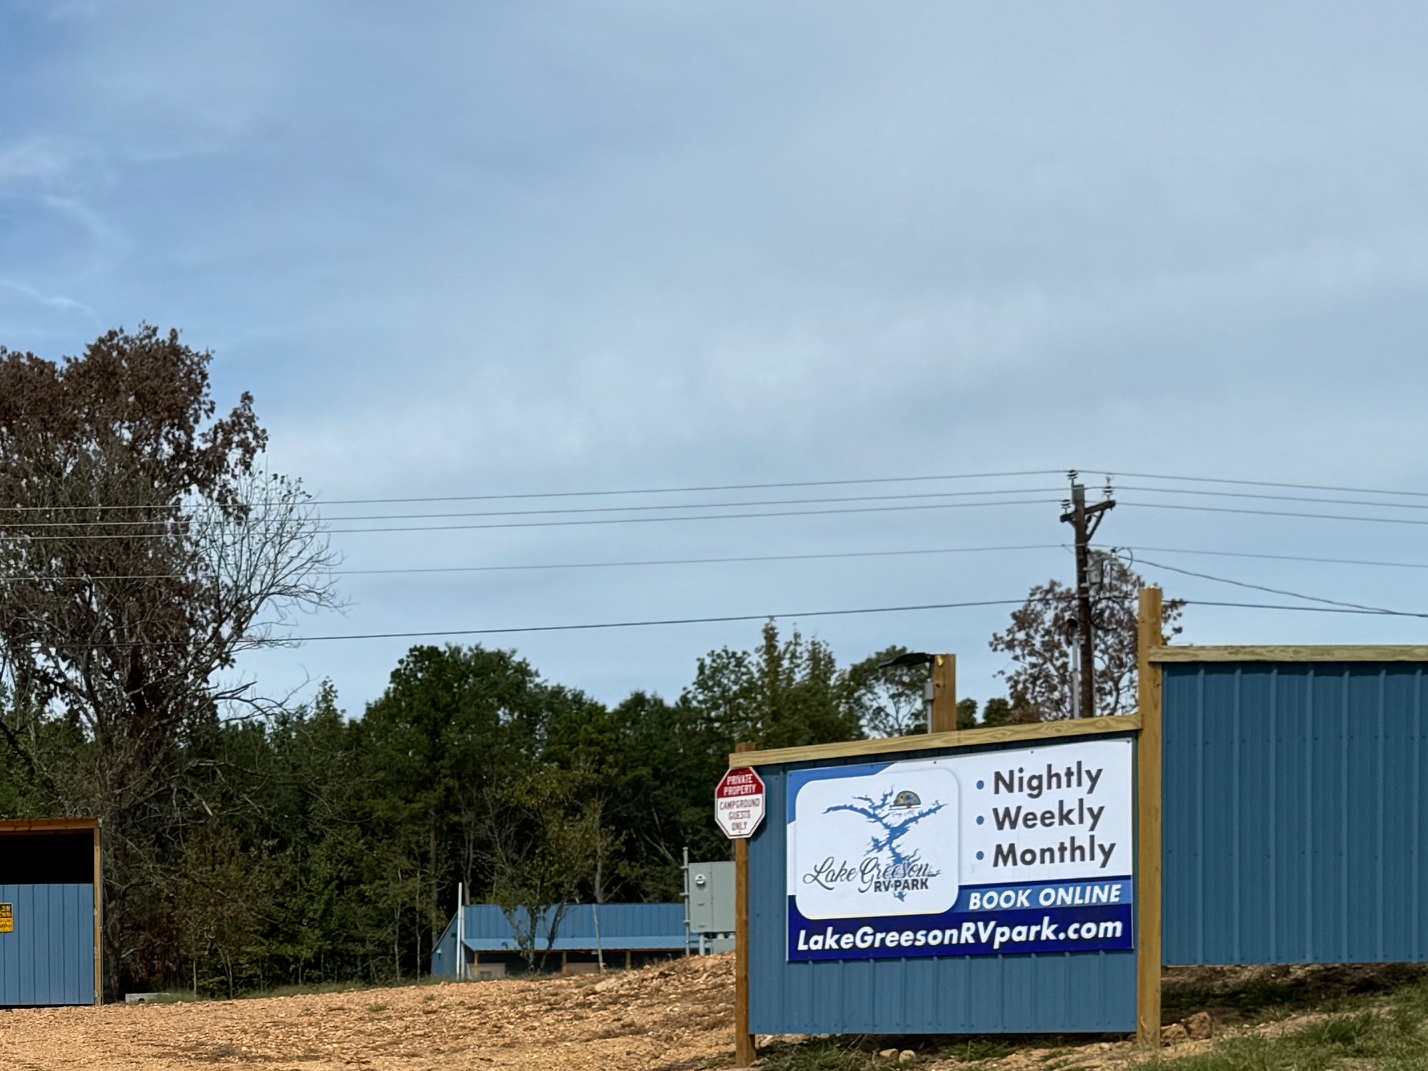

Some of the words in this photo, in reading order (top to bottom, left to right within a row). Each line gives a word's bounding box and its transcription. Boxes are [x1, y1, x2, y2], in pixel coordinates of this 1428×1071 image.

[724, 784, 756, 796] PROPERTY
[727, 774, 753, 785] PRIVATE
[994, 760, 1104, 799] Nightly
[992, 798, 1105, 832] Weekly
[992, 834, 1117, 869] Monthly
[803, 856, 858, 890] Lake
[858, 857, 930, 893] Greeson
[874, 880, 891, 892] RV
[893, 878, 929, 891] PARK
[969, 889, 1032, 910] BOOK
[1039, 884, 1122, 907] ONLINE
[797, 916, 1123, 951] LakeGreesonRVpark.com
